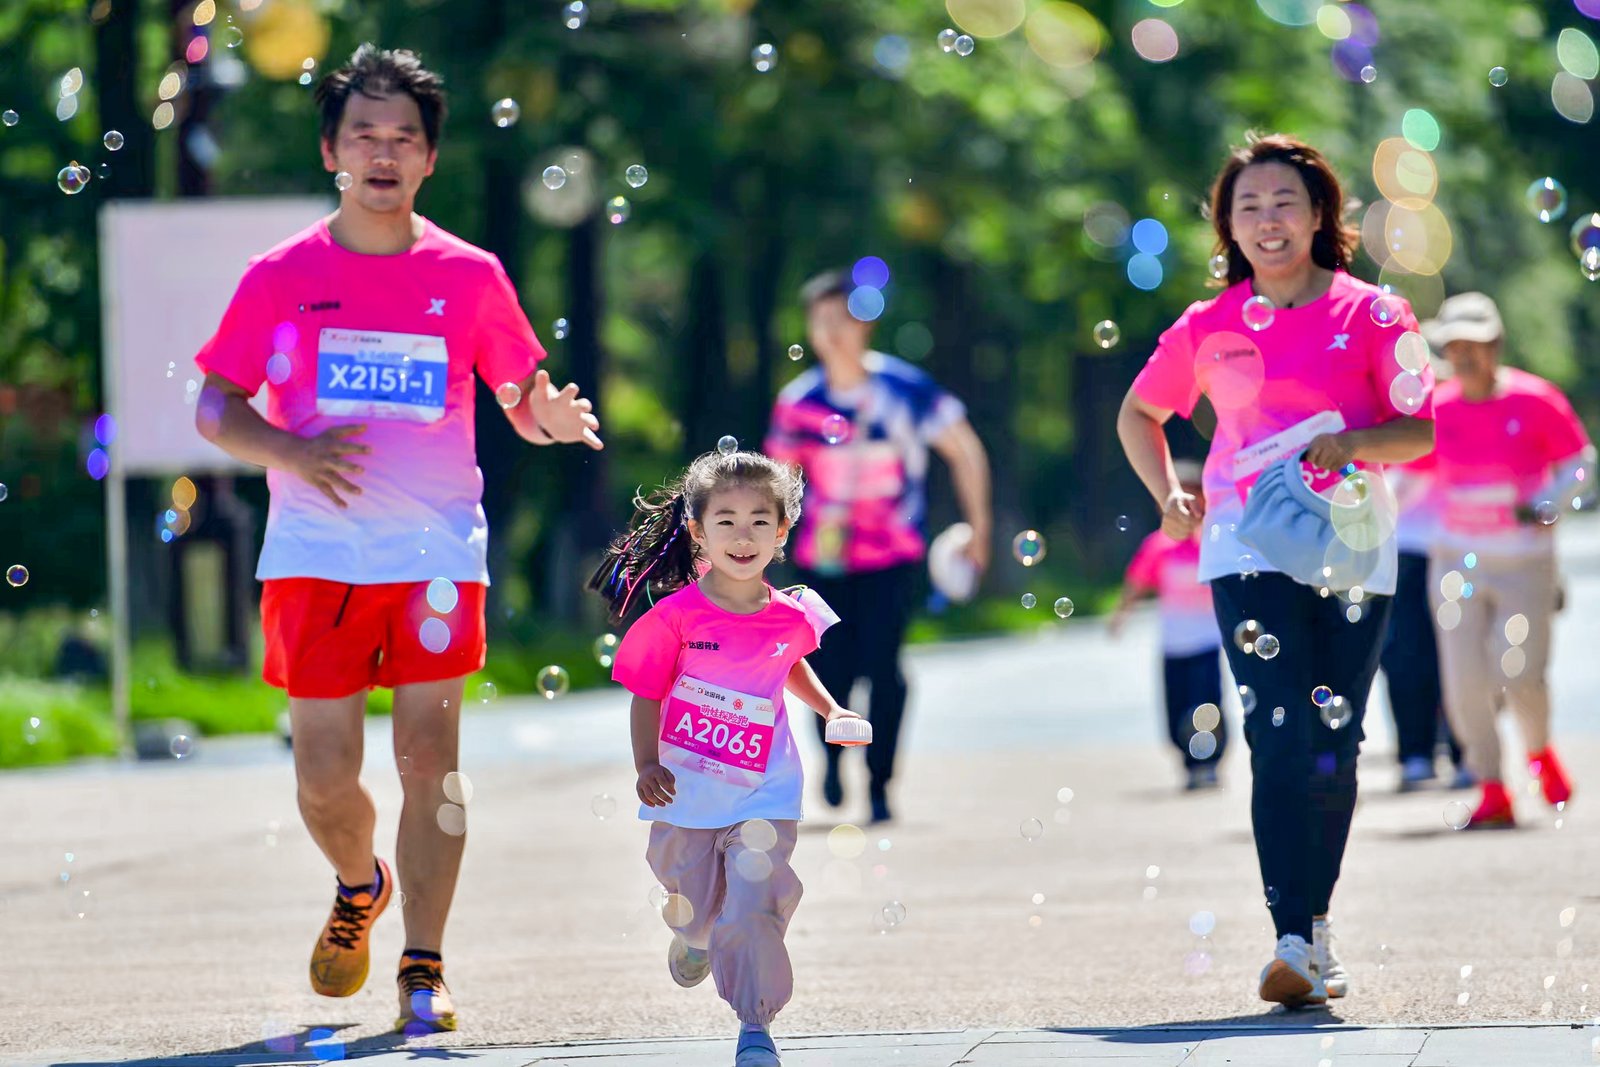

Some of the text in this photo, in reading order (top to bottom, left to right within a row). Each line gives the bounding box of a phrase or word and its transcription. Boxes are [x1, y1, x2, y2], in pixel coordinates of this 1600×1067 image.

[328, 364, 433, 396] X2151-1
[688, 641, 720, 650] 达因药业
[704, 690, 726, 702] 达因药业
[700, 703, 749, 728] 萌娃探险跑
[674, 712, 763, 759] A2065
